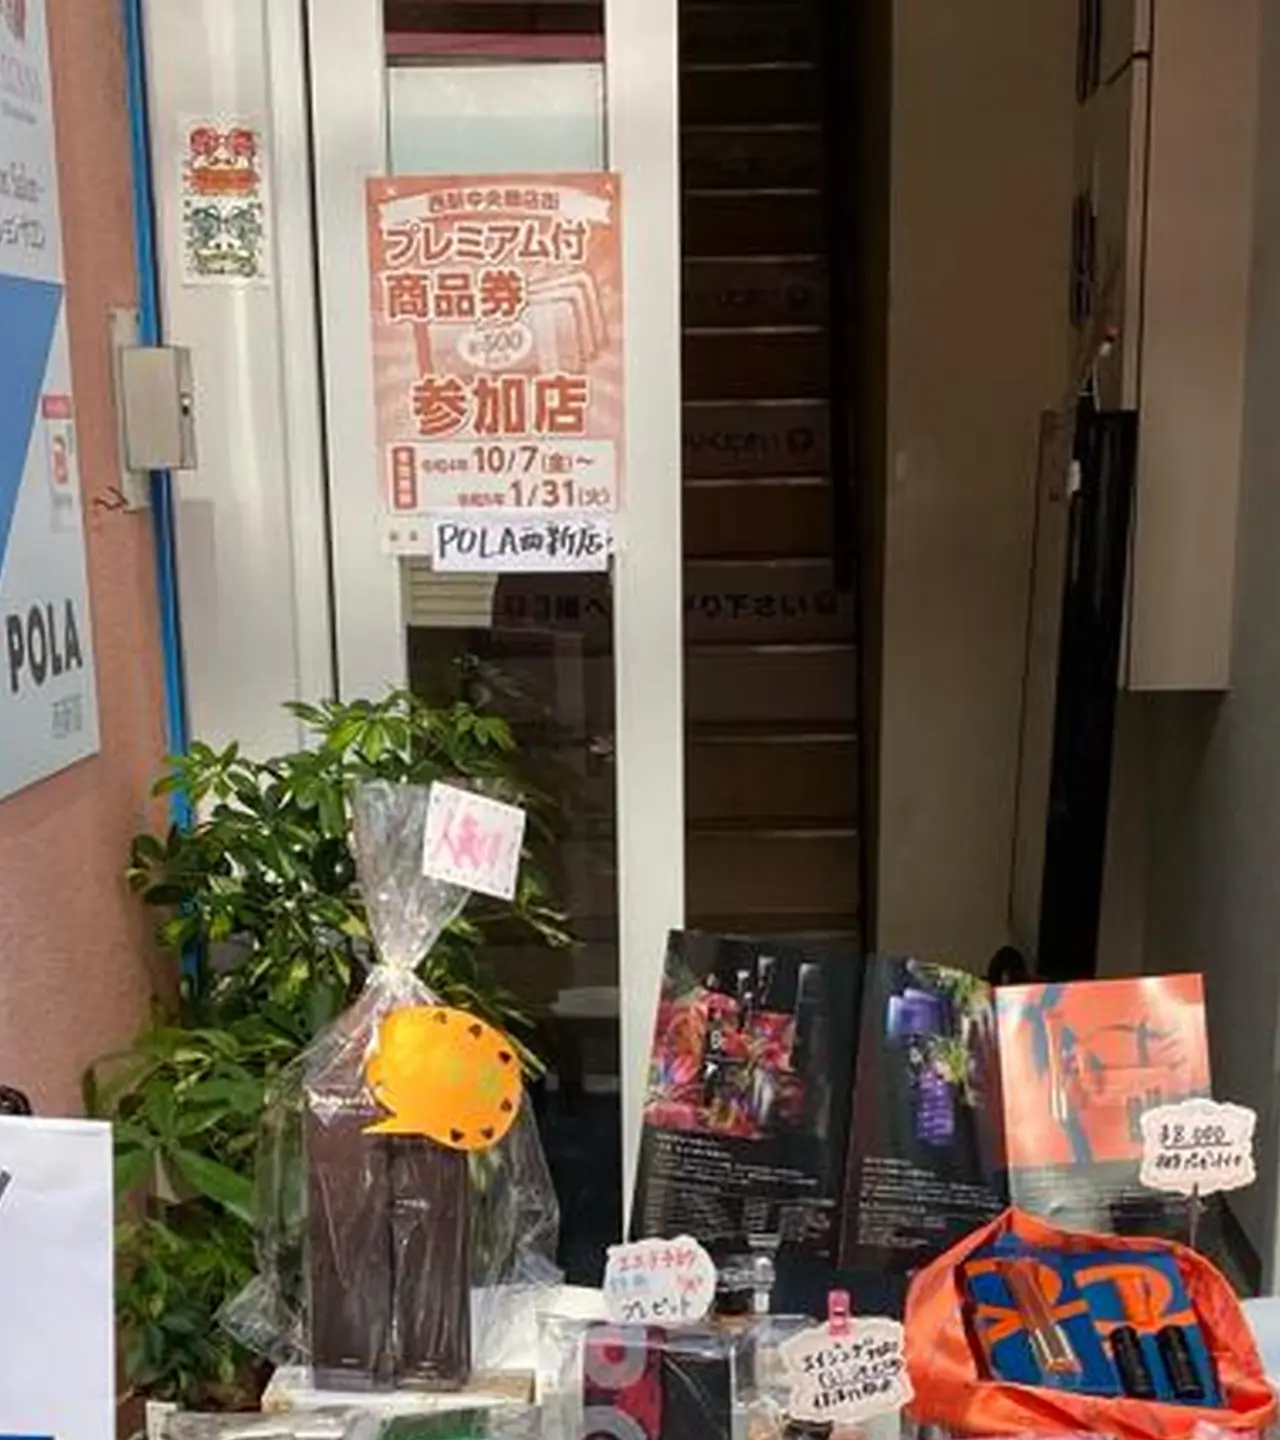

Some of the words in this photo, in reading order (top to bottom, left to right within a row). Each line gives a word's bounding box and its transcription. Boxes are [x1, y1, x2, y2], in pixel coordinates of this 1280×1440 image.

[386, 221, 587, 262] プレミアム付
[386, 270, 523, 319] 商品券
[412, 376, 588, 436] 参加店
[5, 599, 84, 694] POLA
